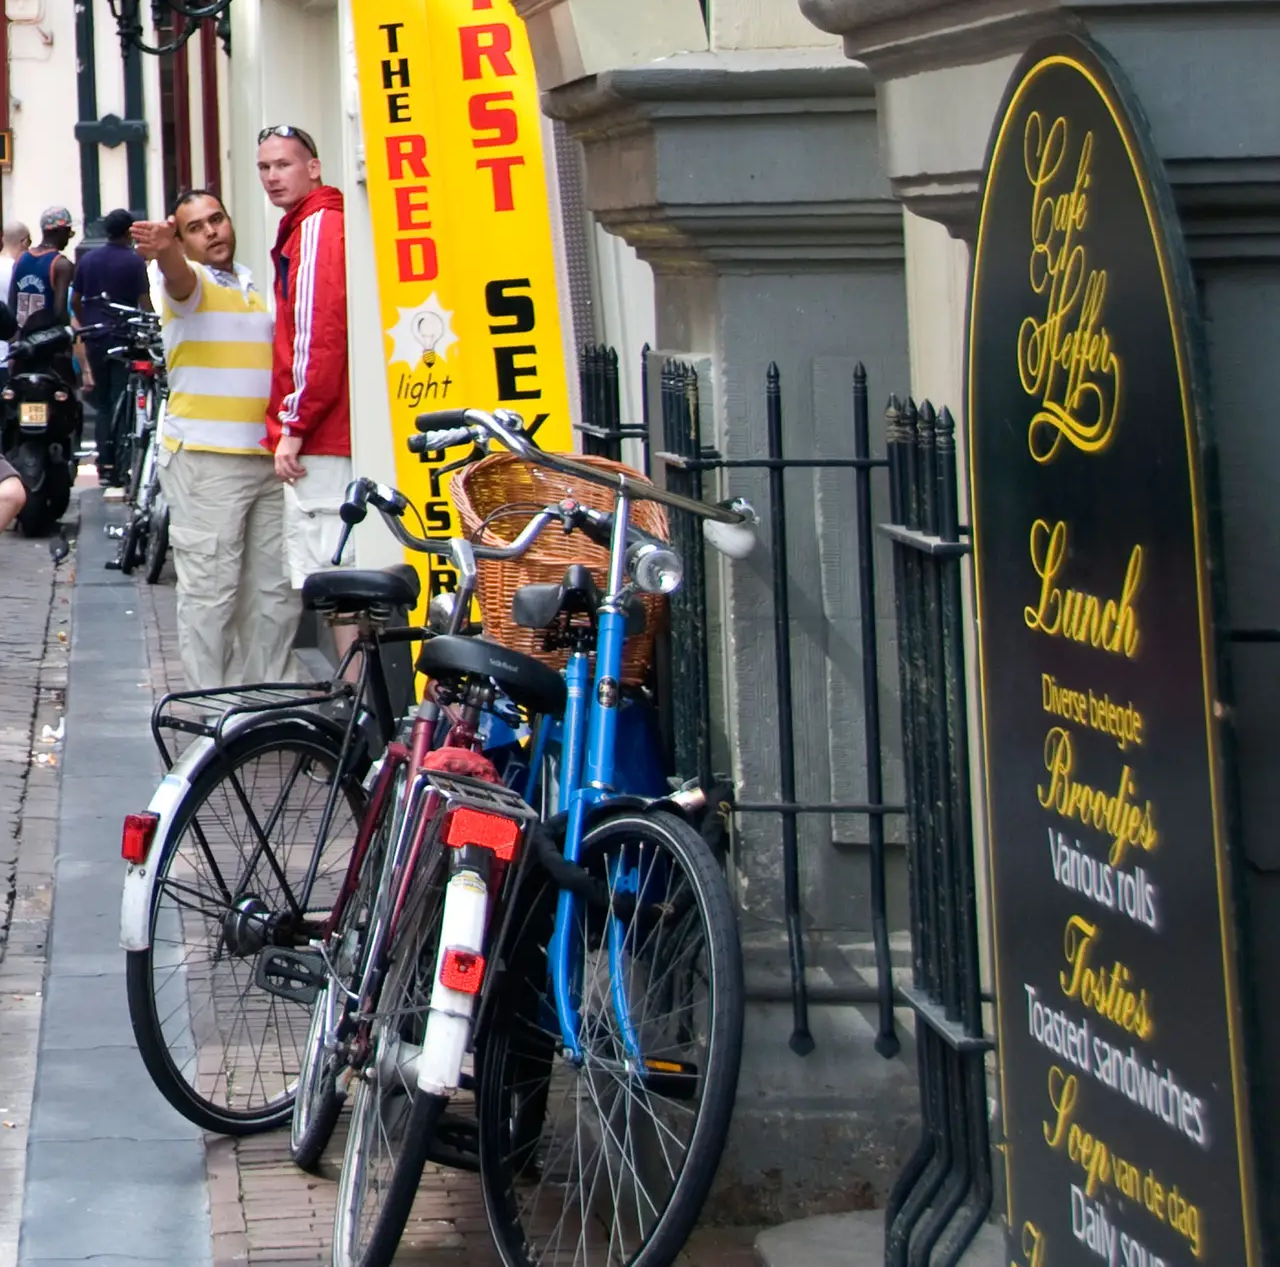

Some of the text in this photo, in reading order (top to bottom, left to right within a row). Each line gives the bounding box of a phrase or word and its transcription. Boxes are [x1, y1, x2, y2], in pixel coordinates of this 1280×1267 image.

[379, 22, 412, 124] THE
[385, 134, 439, 284] RED
[396, 373, 453, 408] light
[1024, 518, 1143, 658] Lunch
[1042, 673, 1143, 750] Diverse belegde
[1037, 727, 1158, 868] Broodjes
[1048, 827, 1157, 930] Various rolls
[1060, 914, 1151, 1039] Tosties
[1023, 982, 1206, 1146] Toasted sandwiches
[1042, 1065, 1201, 1257] Soep van de dag
[1070, 1183, 1118, 1267] Daily
